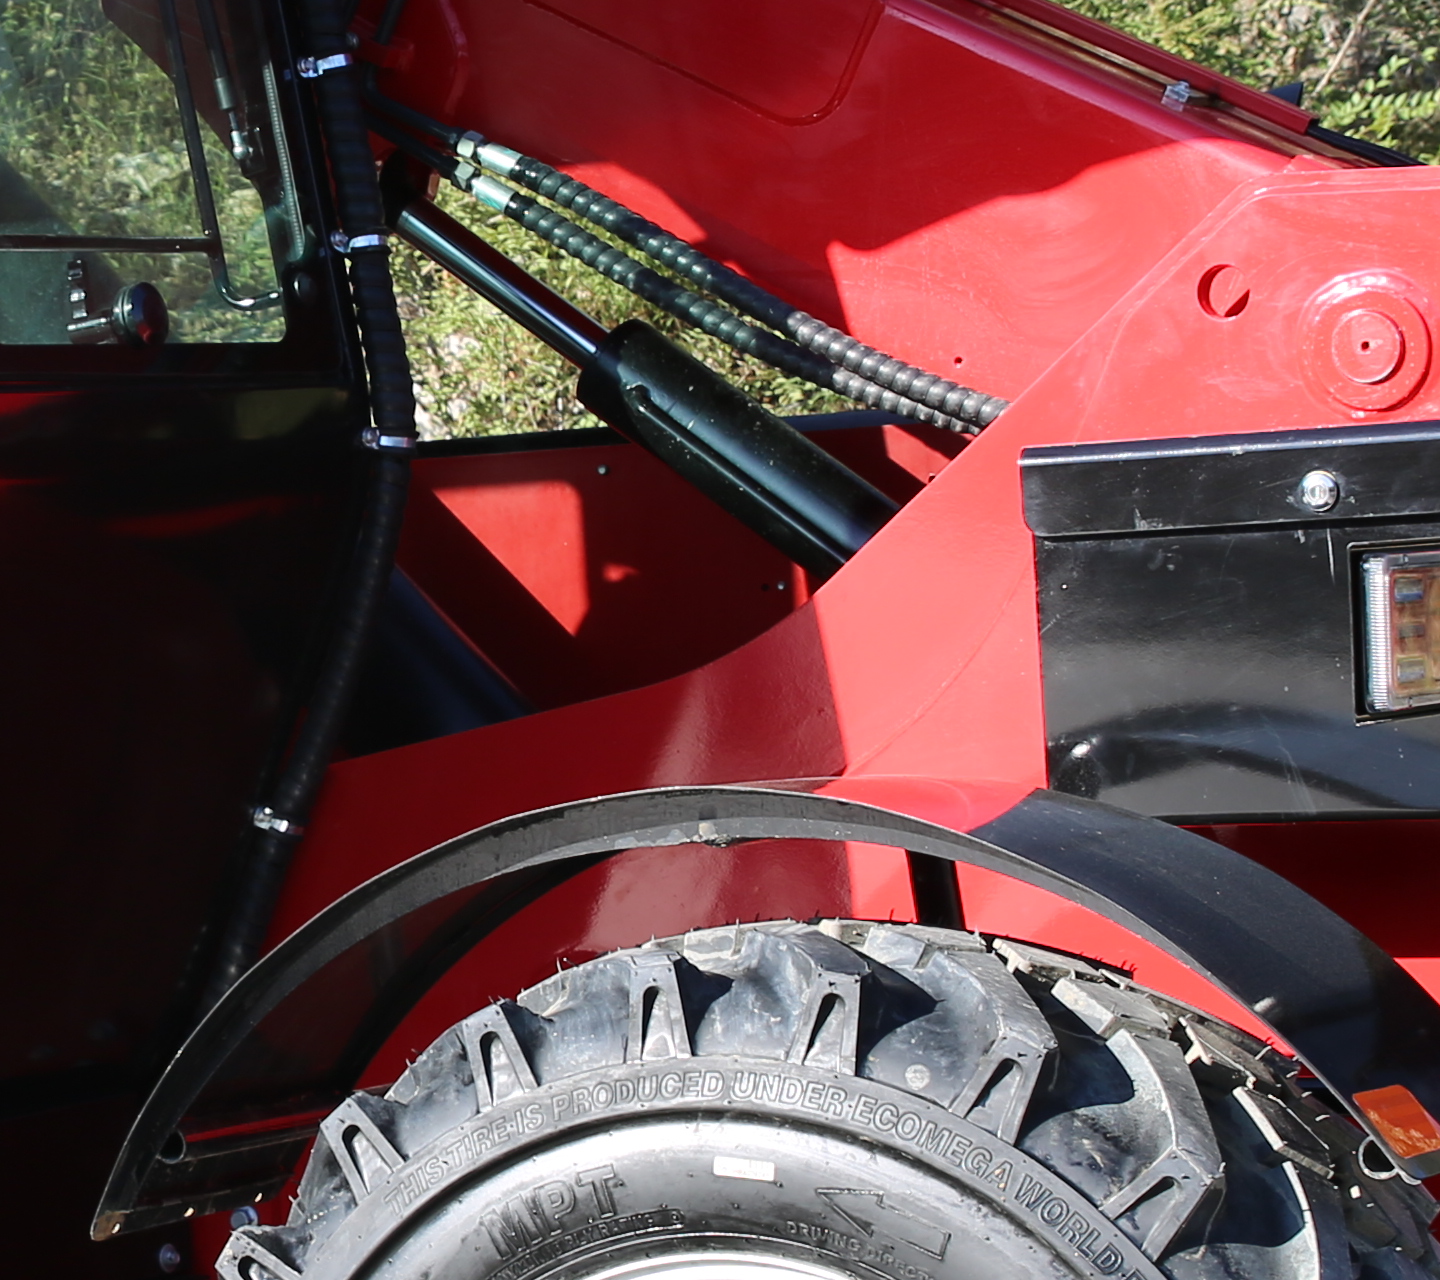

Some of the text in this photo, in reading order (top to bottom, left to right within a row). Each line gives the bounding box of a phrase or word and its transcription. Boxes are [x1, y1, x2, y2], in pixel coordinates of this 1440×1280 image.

[384, 1157, 445, 1215] THIS
[446, 1116, 511, 1171] TIRE
[513, 1104, 545, 1136] IS
[552, 1071, 724, 1121] PRODUCED
[731, 1072, 847, 1117] UNDER
[851, 1094, 1013, 1192] ECOMEGA
[1014, 1173, 1124, 1275] WORLD
[480, 1164, 616, 1260] MPT
[786, 1221, 861, 1252] DRIVING
